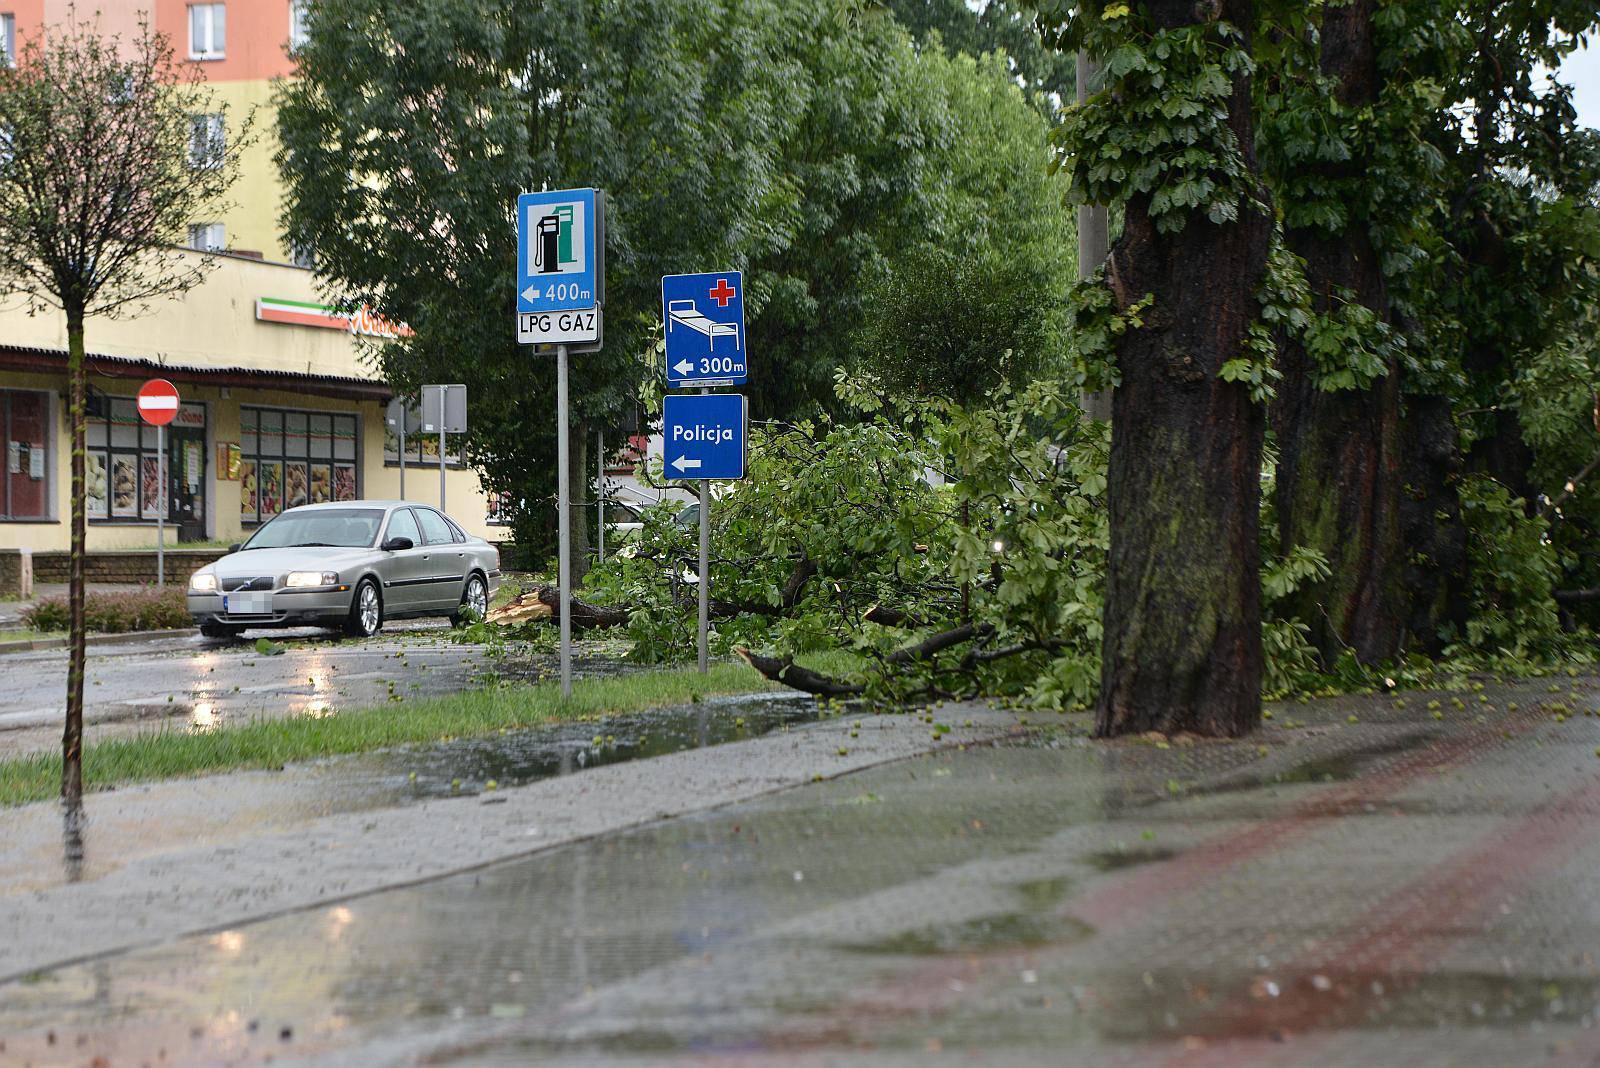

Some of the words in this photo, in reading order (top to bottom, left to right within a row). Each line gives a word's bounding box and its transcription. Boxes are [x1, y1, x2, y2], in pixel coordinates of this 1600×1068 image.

[545, 283, 590, 301] 400m
[520, 315, 551, 333] LPG
[558, 314, 594, 331] GAZ
[700, 357, 744, 374] 300m
[673, 424, 733, 445] Policja
